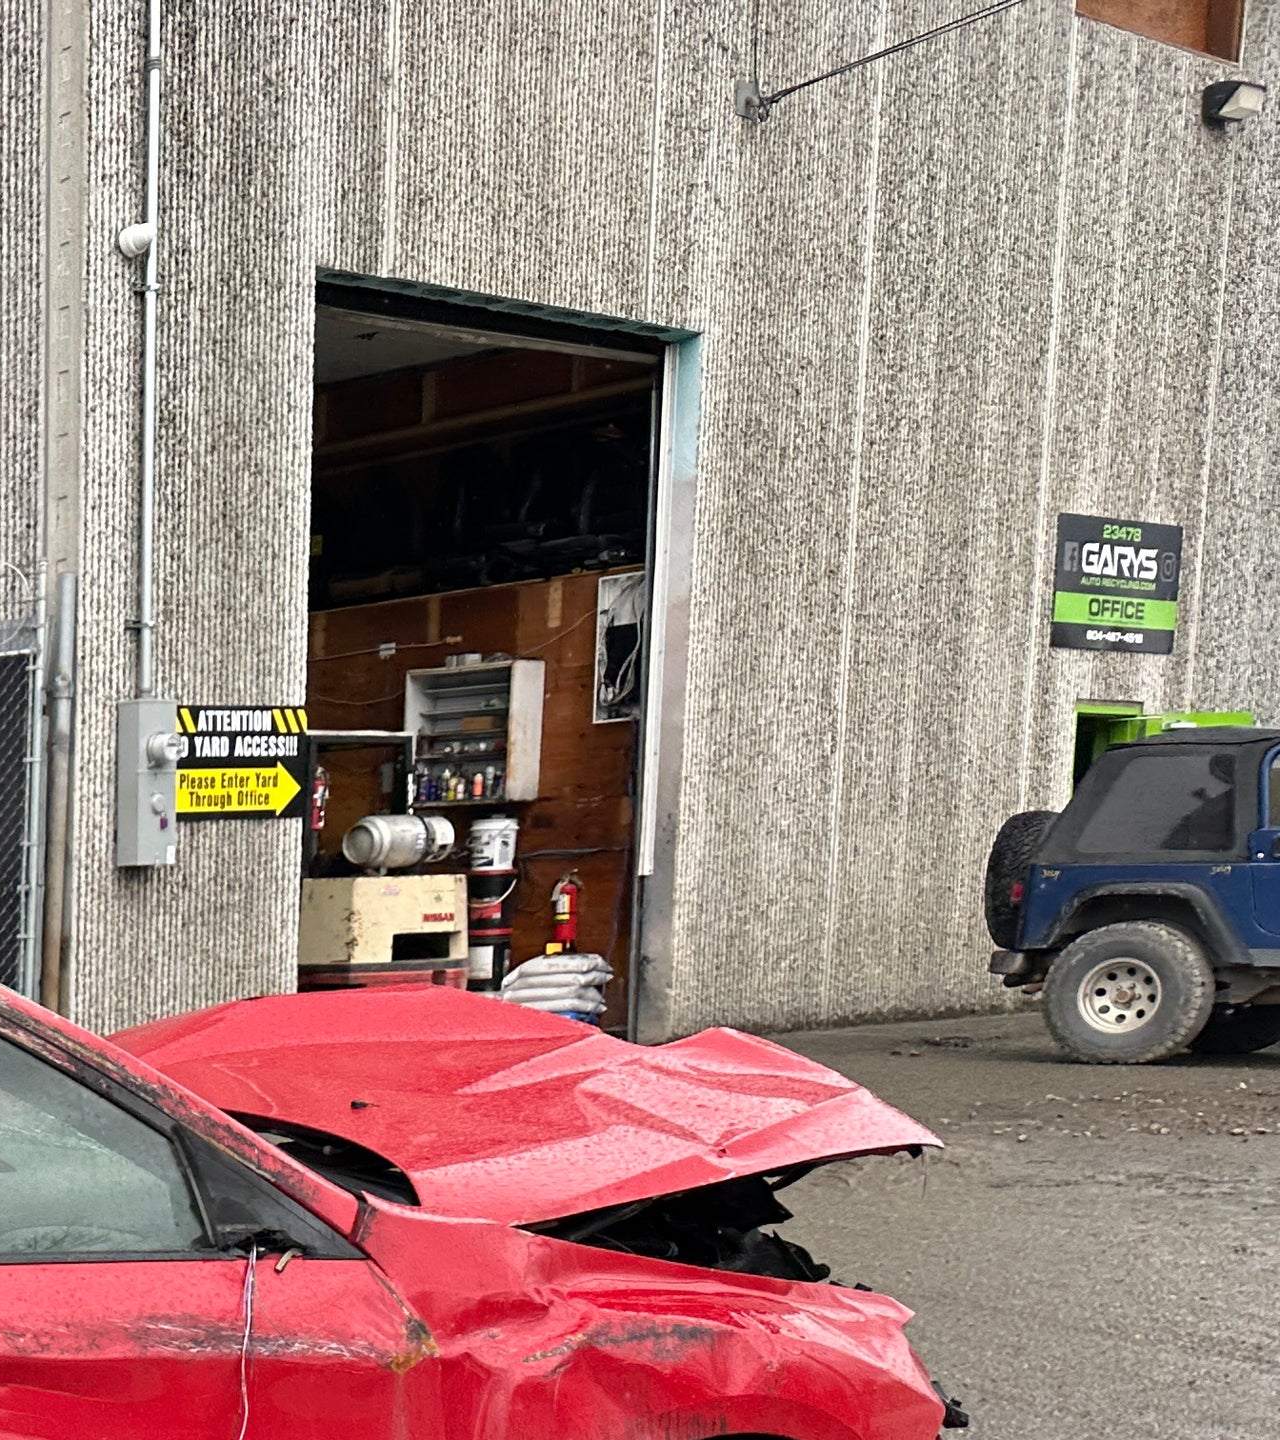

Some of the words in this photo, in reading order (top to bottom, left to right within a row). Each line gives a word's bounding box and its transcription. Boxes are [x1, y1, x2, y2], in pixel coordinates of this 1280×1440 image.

[1103, 524, 1141, 541] 23478
[1082, 543, 1158, 579] GARYS
[1081, 576, 1100, 586] AUTO
[1089, 598, 1145, 619] OFFICE
[198, 710, 271, 731] ATTENTION
[194, 736, 229, 757] YARD
[234, 736, 297, 756] ACCESS!!!
[180, 774, 215, 789] Please
[221, 773, 250, 788] Enter
[255, 772, 278, 787] Yard
[189, 791, 231, 808] Through
[238, 791, 269, 805] Office
